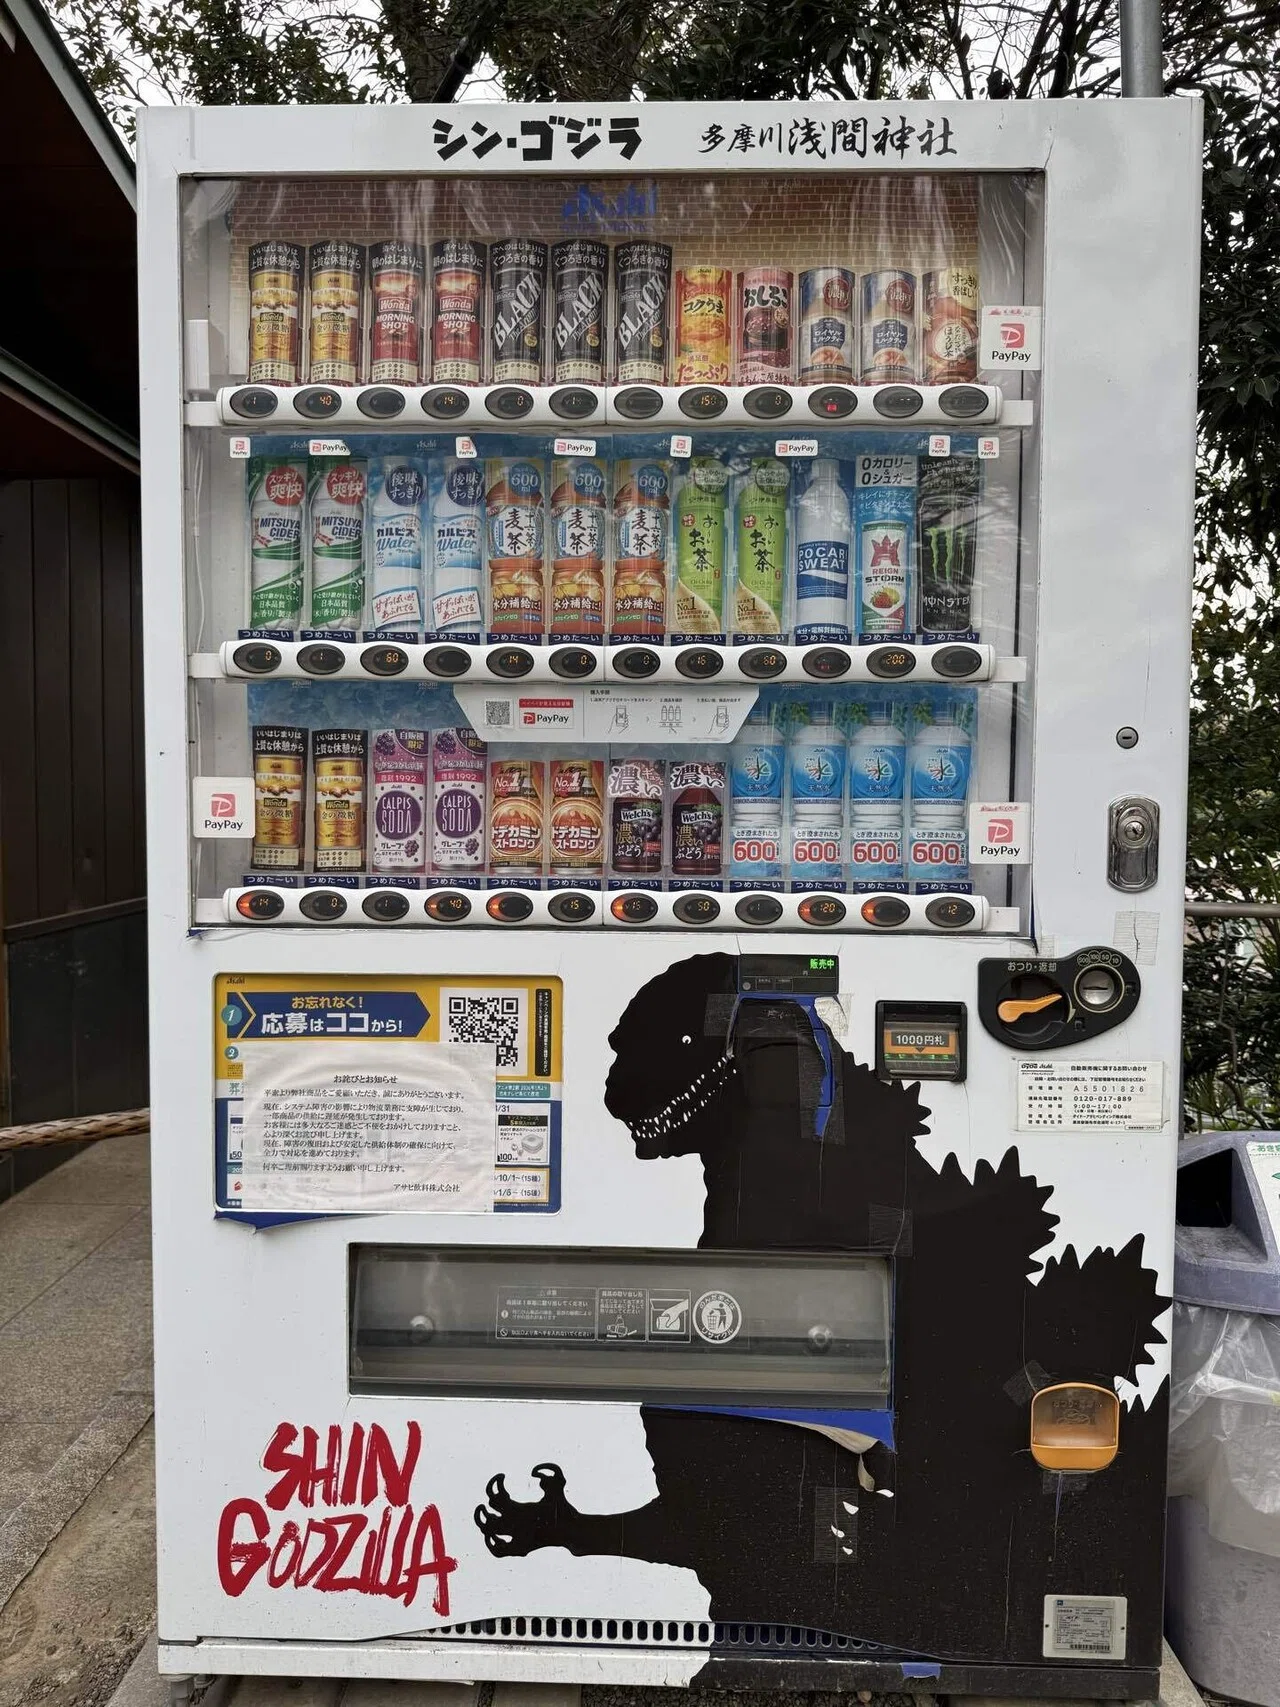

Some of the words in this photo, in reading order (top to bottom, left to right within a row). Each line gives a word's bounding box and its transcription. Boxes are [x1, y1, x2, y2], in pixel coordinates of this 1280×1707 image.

[432, 117, 643, 162] シン・ゴジラ
[699, 115, 958, 160] 多摩川浅間神社
[380, 299, 411, 311] Wonda
[494, 271, 541, 351] BLACK
[556, 272, 603, 351] BLACK
[618, 273, 667, 351] BLACK
[684, 298, 725, 314] コクうま
[377, 313, 415, 324] MORNING
[438, 312, 476, 323] MORNING
[381, 321, 408, 331] SHOT
[443, 320, 471, 330] SHOT
[992, 350, 1031, 363] PayPay
[677, 362, 729, 382] たっぷり
[322, 443, 346, 452] PayPay
[567, 443, 592, 453] PayPay
[789, 443, 814, 453] PayPay
[862, 457, 912, 471] 0カロリー
[268, 471, 298, 484] スッキリ
[330, 470, 359, 483] スッキリ
[391, 471, 418, 487] 後味
[452, 471, 479, 487] 後味
[511, 473, 539, 487] 600
[575, 473, 602, 487] 600
[639, 474, 666, 489] 600
[862, 471, 912, 485] 0シュガー
[270, 482, 303, 500] 爽快
[332, 480, 363, 499] 爽快
[390, 484, 422, 499] すっきり
[451, 484, 484, 499] すっきり
[260, 517, 300, 530] MITSUYA
[321, 516, 361, 529] MITSUYA
[269, 527, 300, 539] CIDER
[331, 526, 362, 538] CIDER
[376, 527, 415, 537] カルピス
[437, 528, 476, 538] カルピス
[505, 508, 527, 554] 麦茶
[568, 508, 590, 554] 麦茶
[631, 509, 653, 555] 麦茶
[376, 537, 416, 552] Water
[436, 537, 477, 552] Water
[688, 528, 714, 572] お茶
[749, 529, 775, 573] お茶
[799, 558, 845, 571] SWEAT
[872, 567, 899, 575] REIGN
[257, 730, 302, 739] いいはじまりは
[316, 733, 361, 741] いいはじまりは
[255, 740, 304, 752] 上質な休憩から
[315, 743, 364, 755] 上質な休憩から
[609, 765, 662, 795] 濃い
[671, 764, 725, 788] 濃い
[382, 796, 411, 810] CALPIS
[442, 795, 472, 808] CALPIS
[442, 808, 472, 832] SODA
[622, 809, 652, 819] Welch's
[682, 812, 712, 822] Welch's
[381, 809, 412, 834] SODA
[491, 825, 540, 839] ドデカミン
[552, 825, 600, 839] ドデカミン
[616, 822, 643, 844] 濃い
[676, 825, 704, 847] 濃い
[381, 842, 405, 850] グレープ
[441, 841, 465, 849] グレープ
[495, 839, 535, 849] ストロング
[555, 840, 596, 850] ストロング
[615, 844, 641, 857] ぶどう
[734, 841, 776, 861] 600
[675, 846, 702, 860] ぶどう
[795, 842, 836, 861] 600
[853, 842, 896, 862] 600
[810, 958, 835, 969] 販売中
[1007, 962, 1057, 973] おつり・返却
[896, 1034, 945, 1045] 1000円札
[333, 1075, 398, 1084] お詫びとお知らせ
[393, 1183, 461, 1193] アサヒ飲料株式会社
[263, 1421, 422, 1510] SHIN
[217, 1496, 458, 1617] GODZILLA
